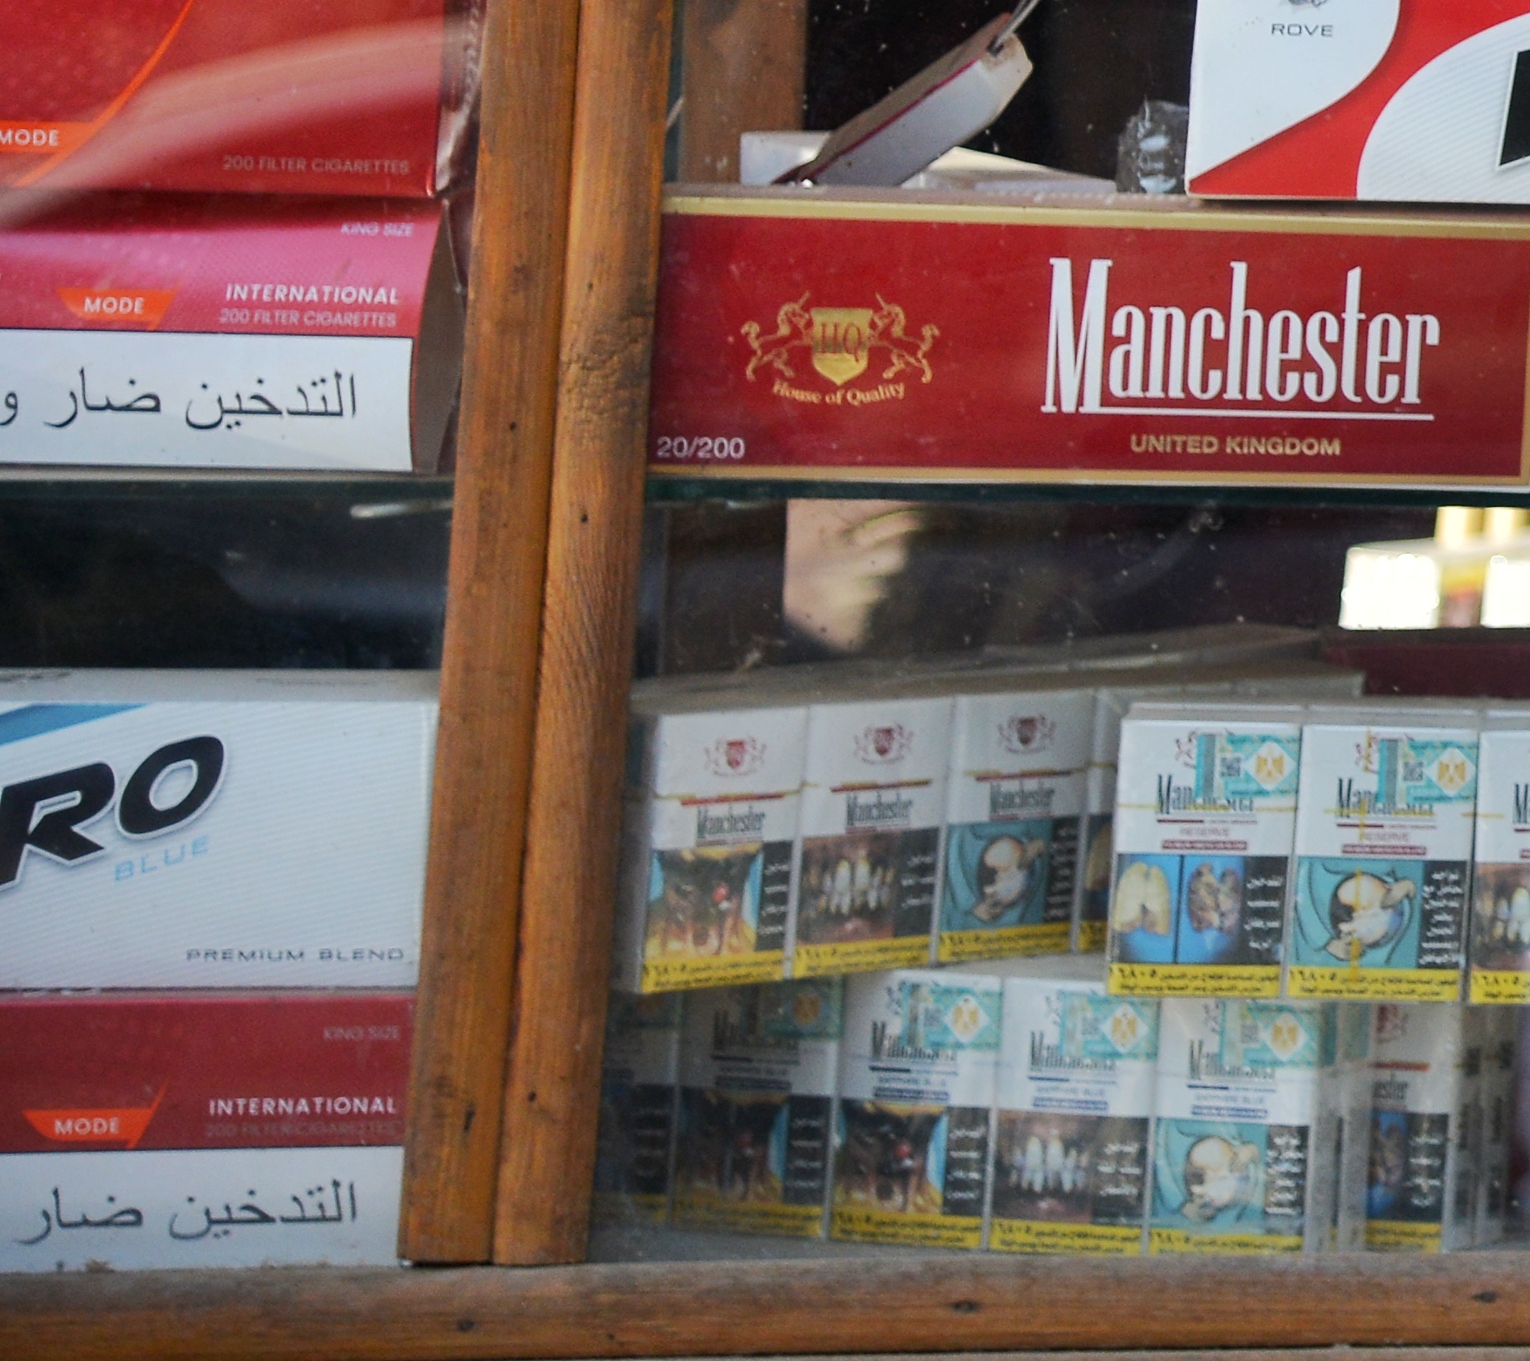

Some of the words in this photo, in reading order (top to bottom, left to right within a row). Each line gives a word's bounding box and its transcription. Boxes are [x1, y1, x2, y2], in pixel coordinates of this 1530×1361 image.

[1270, 22, 1335, 39] ROVE
[0, 129, 59, 147] MODE
[222, 156, 254, 172] 200
[258, 157, 307, 173] FILTER
[311, 158, 411, 175] CIGARETTES
[341, 221, 380, 236] KING
[383, 223, 415, 238] SIZE
[225, 283, 400, 305] INTERNATIONAL
[83, 296, 144, 316] MODE
[219, 308, 249, 324] 200
[252, 309, 300, 326] FILTER
[303, 310, 397, 328] CIGARETTES
[817, 318, 867, 360] HQ
[1041, 257, 1440, 420] Manchester
[43, 366, 161, 429] ضار
[184, 370, 358, 431] التدخين
[772, 381, 821, 404] House
[824, 388, 843, 406] of
[846, 381, 907, 408] Quality
[656, 435, 746, 461] 20/200
[1130, 433, 1220, 457] UNITED
[1225, 435, 1342, 458] KINGDOM
[113, 834, 211, 883] BLUE
[185, 947, 305, 962] PREMIUM
[318, 947, 405, 962] BLEND
[208, 1095, 397, 1117] INTERNATIONAL
[54, 1116, 120, 1137] MODE
[18, 1181, 145, 1245] ضار
[168, 1178, 358, 1240] التدخين
